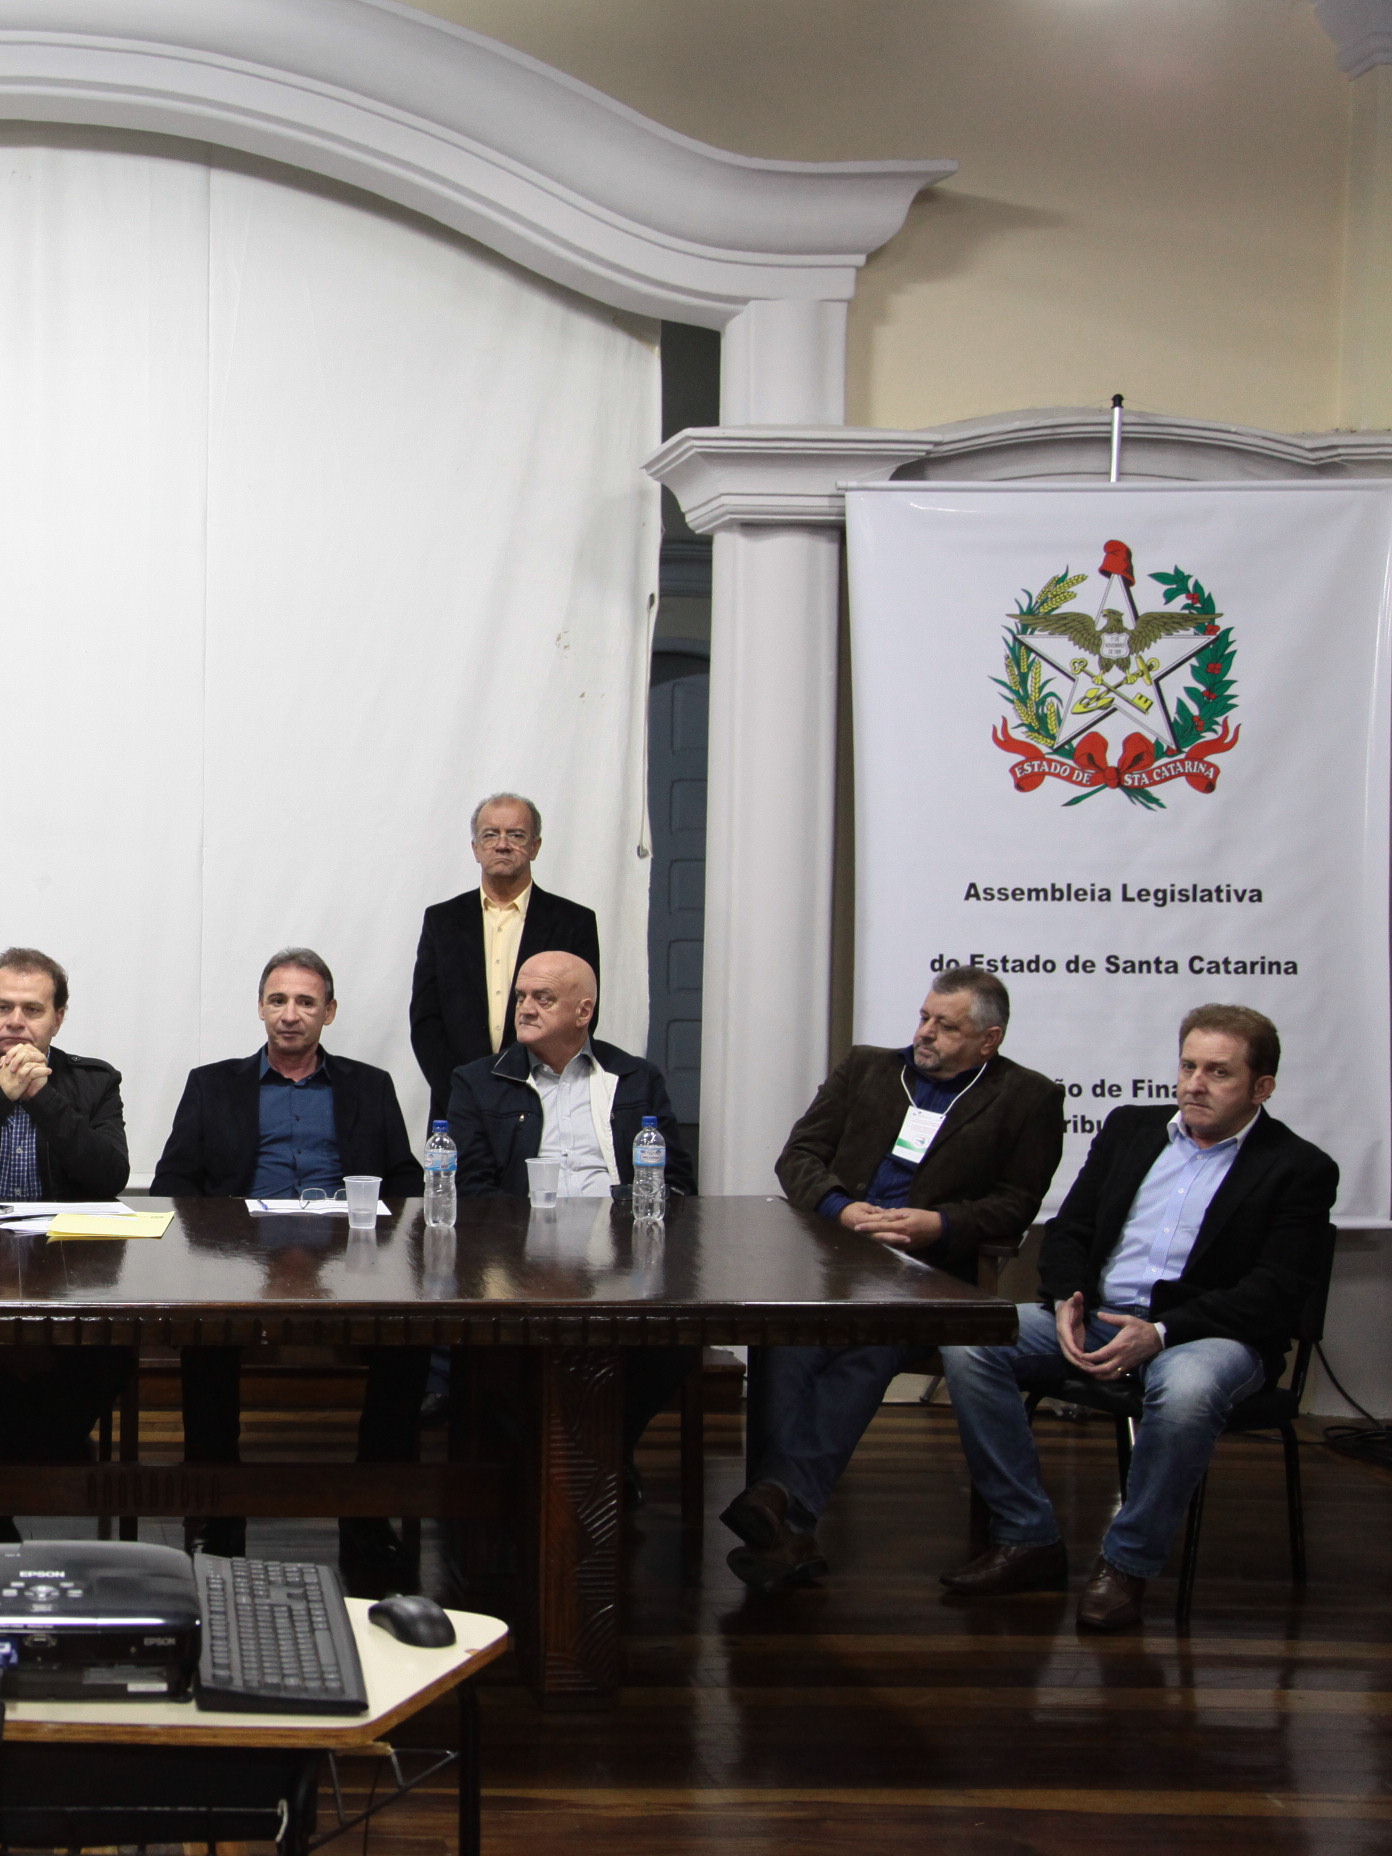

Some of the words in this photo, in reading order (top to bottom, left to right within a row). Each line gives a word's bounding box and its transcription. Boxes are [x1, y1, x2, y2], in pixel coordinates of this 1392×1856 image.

[1014, 760, 1070, 778] ESTADO
[1072, 769, 1092, 785] DE
[1153, 760, 1215, 780] CATARINA
[963, 882, 1112, 903] Assembleia
[1121, 883, 1264, 908] Legislativa
[930, 953, 960, 973] do
[969, 953, 1057, 974] Estado
[1065, 954, 1096, 974] de
[1105, 954, 1179, 975] Santa
[1188, 955, 1299, 976] Catarina
[1091, 1079, 1123, 1099] de
[19, 1570, 66, 1578] EPSON
[143, 1637, 176, 1647] EPSON
